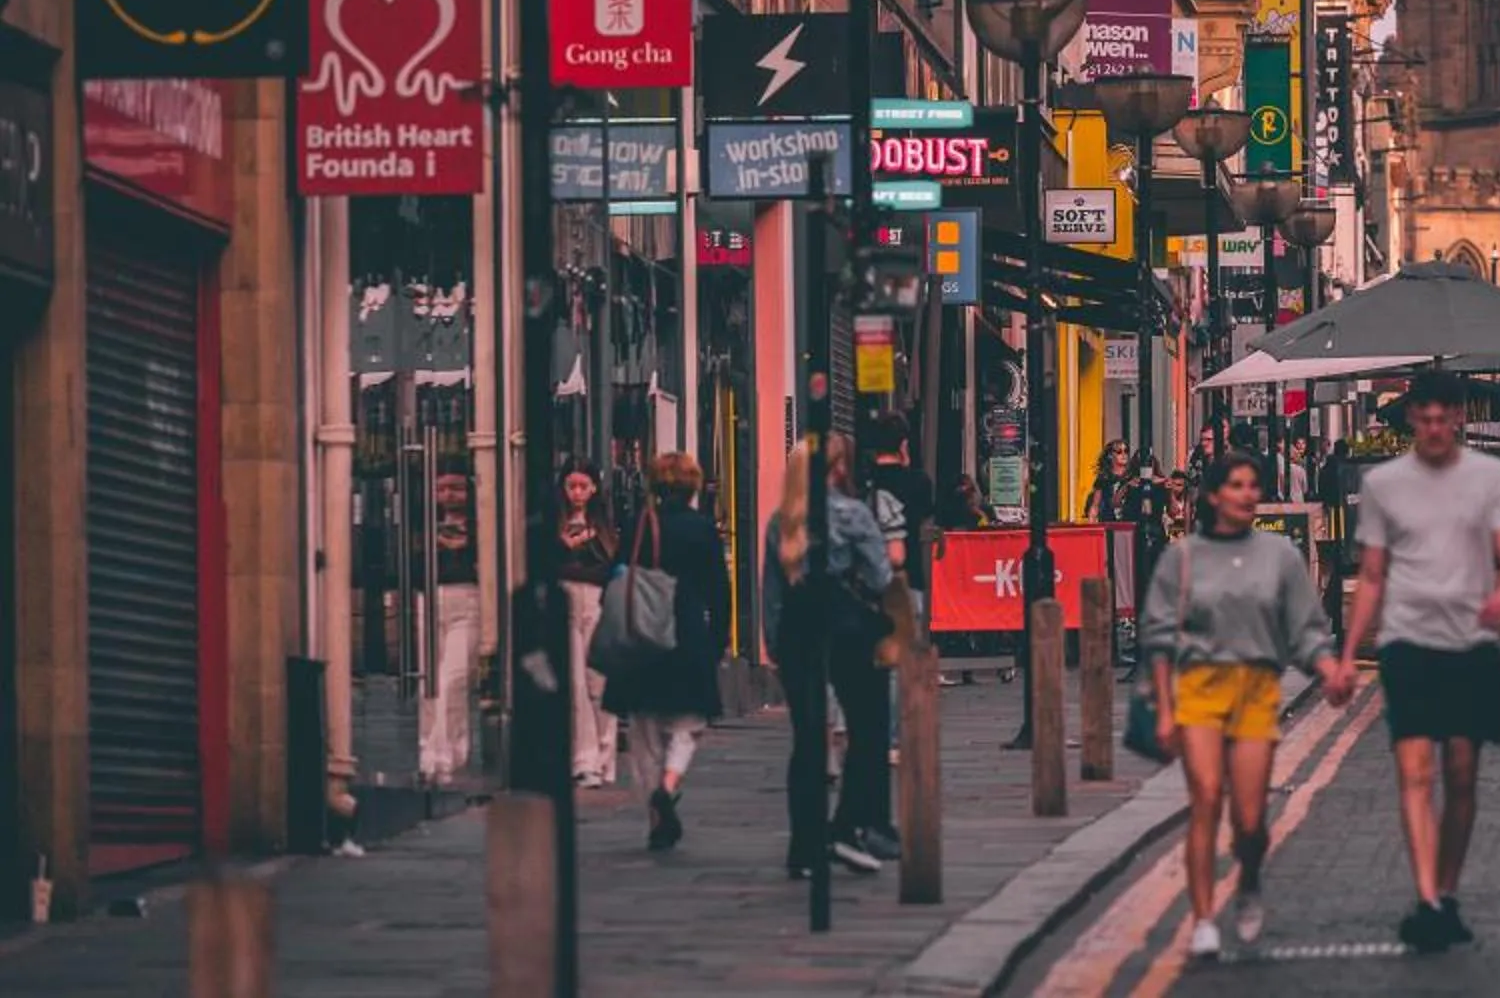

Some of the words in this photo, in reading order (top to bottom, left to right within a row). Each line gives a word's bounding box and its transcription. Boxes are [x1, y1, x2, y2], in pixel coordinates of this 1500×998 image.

[565, 42, 630, 71] Gong
[632, 41, 673, 63] cha
[1325, 28, 1340, 144] TATTOO
[306, 123, 391, 149] British
[397, 123, 473, 148] Heart
[1052, 223, 1106, 233] SERVE
[1053, 209, 1106, 223] SOFT
